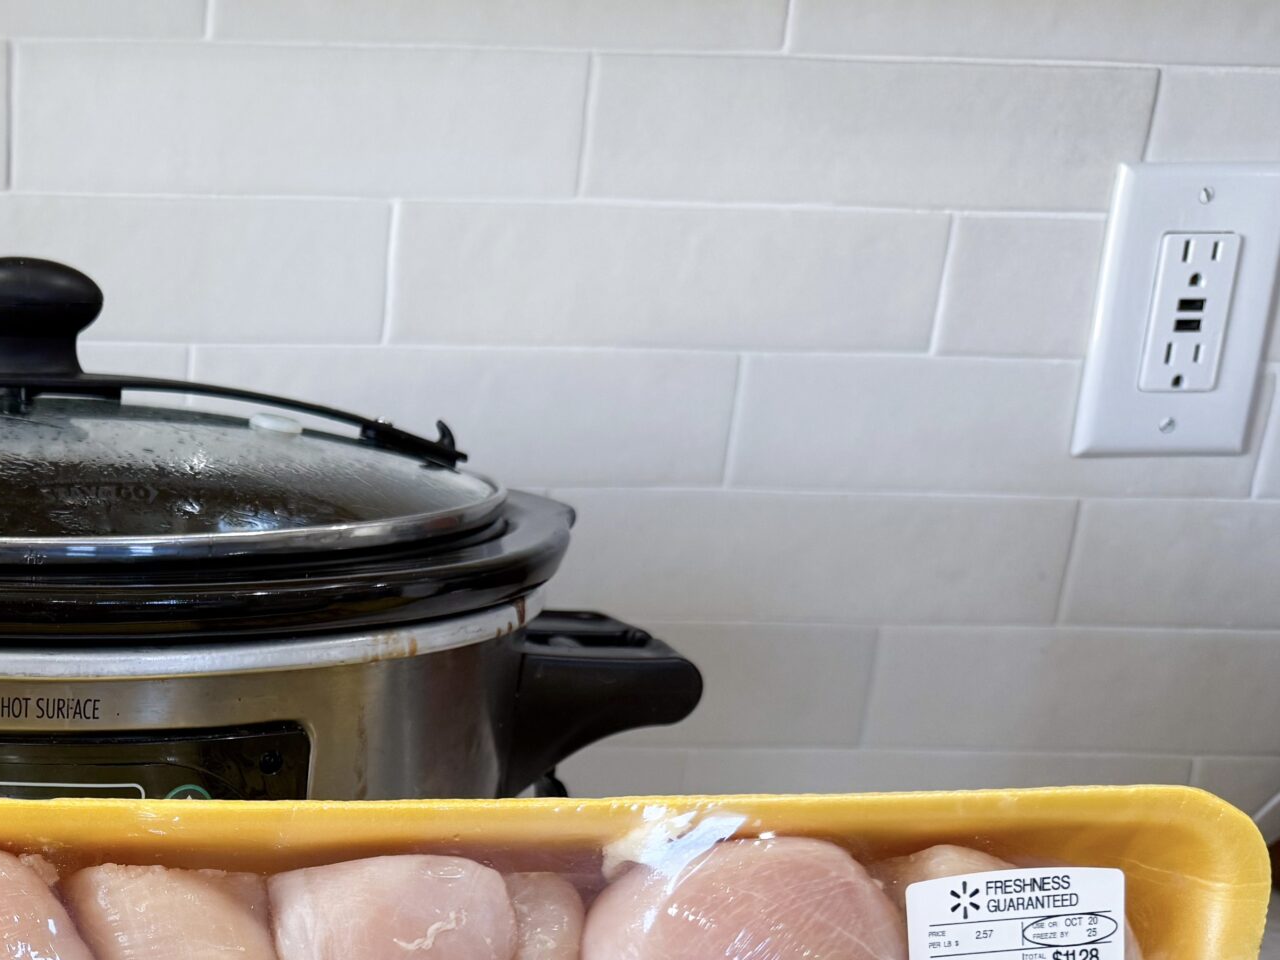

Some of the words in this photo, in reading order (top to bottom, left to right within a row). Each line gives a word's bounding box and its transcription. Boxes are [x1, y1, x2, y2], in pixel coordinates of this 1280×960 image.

[0, 697, 30, 719] HOT
[35, 698, 100, 720] SURFACE
[985, 875, 1071, 895] FRESHNESS
[986, 893, 1079, 913] GUARANTEED
[1064, 917, 1083, 927] OCT
[1088, 917, 1098, 925] 20
[975, 929, 993, 939] 2.57
[1032, 932, 1057, 940] FREEZE
